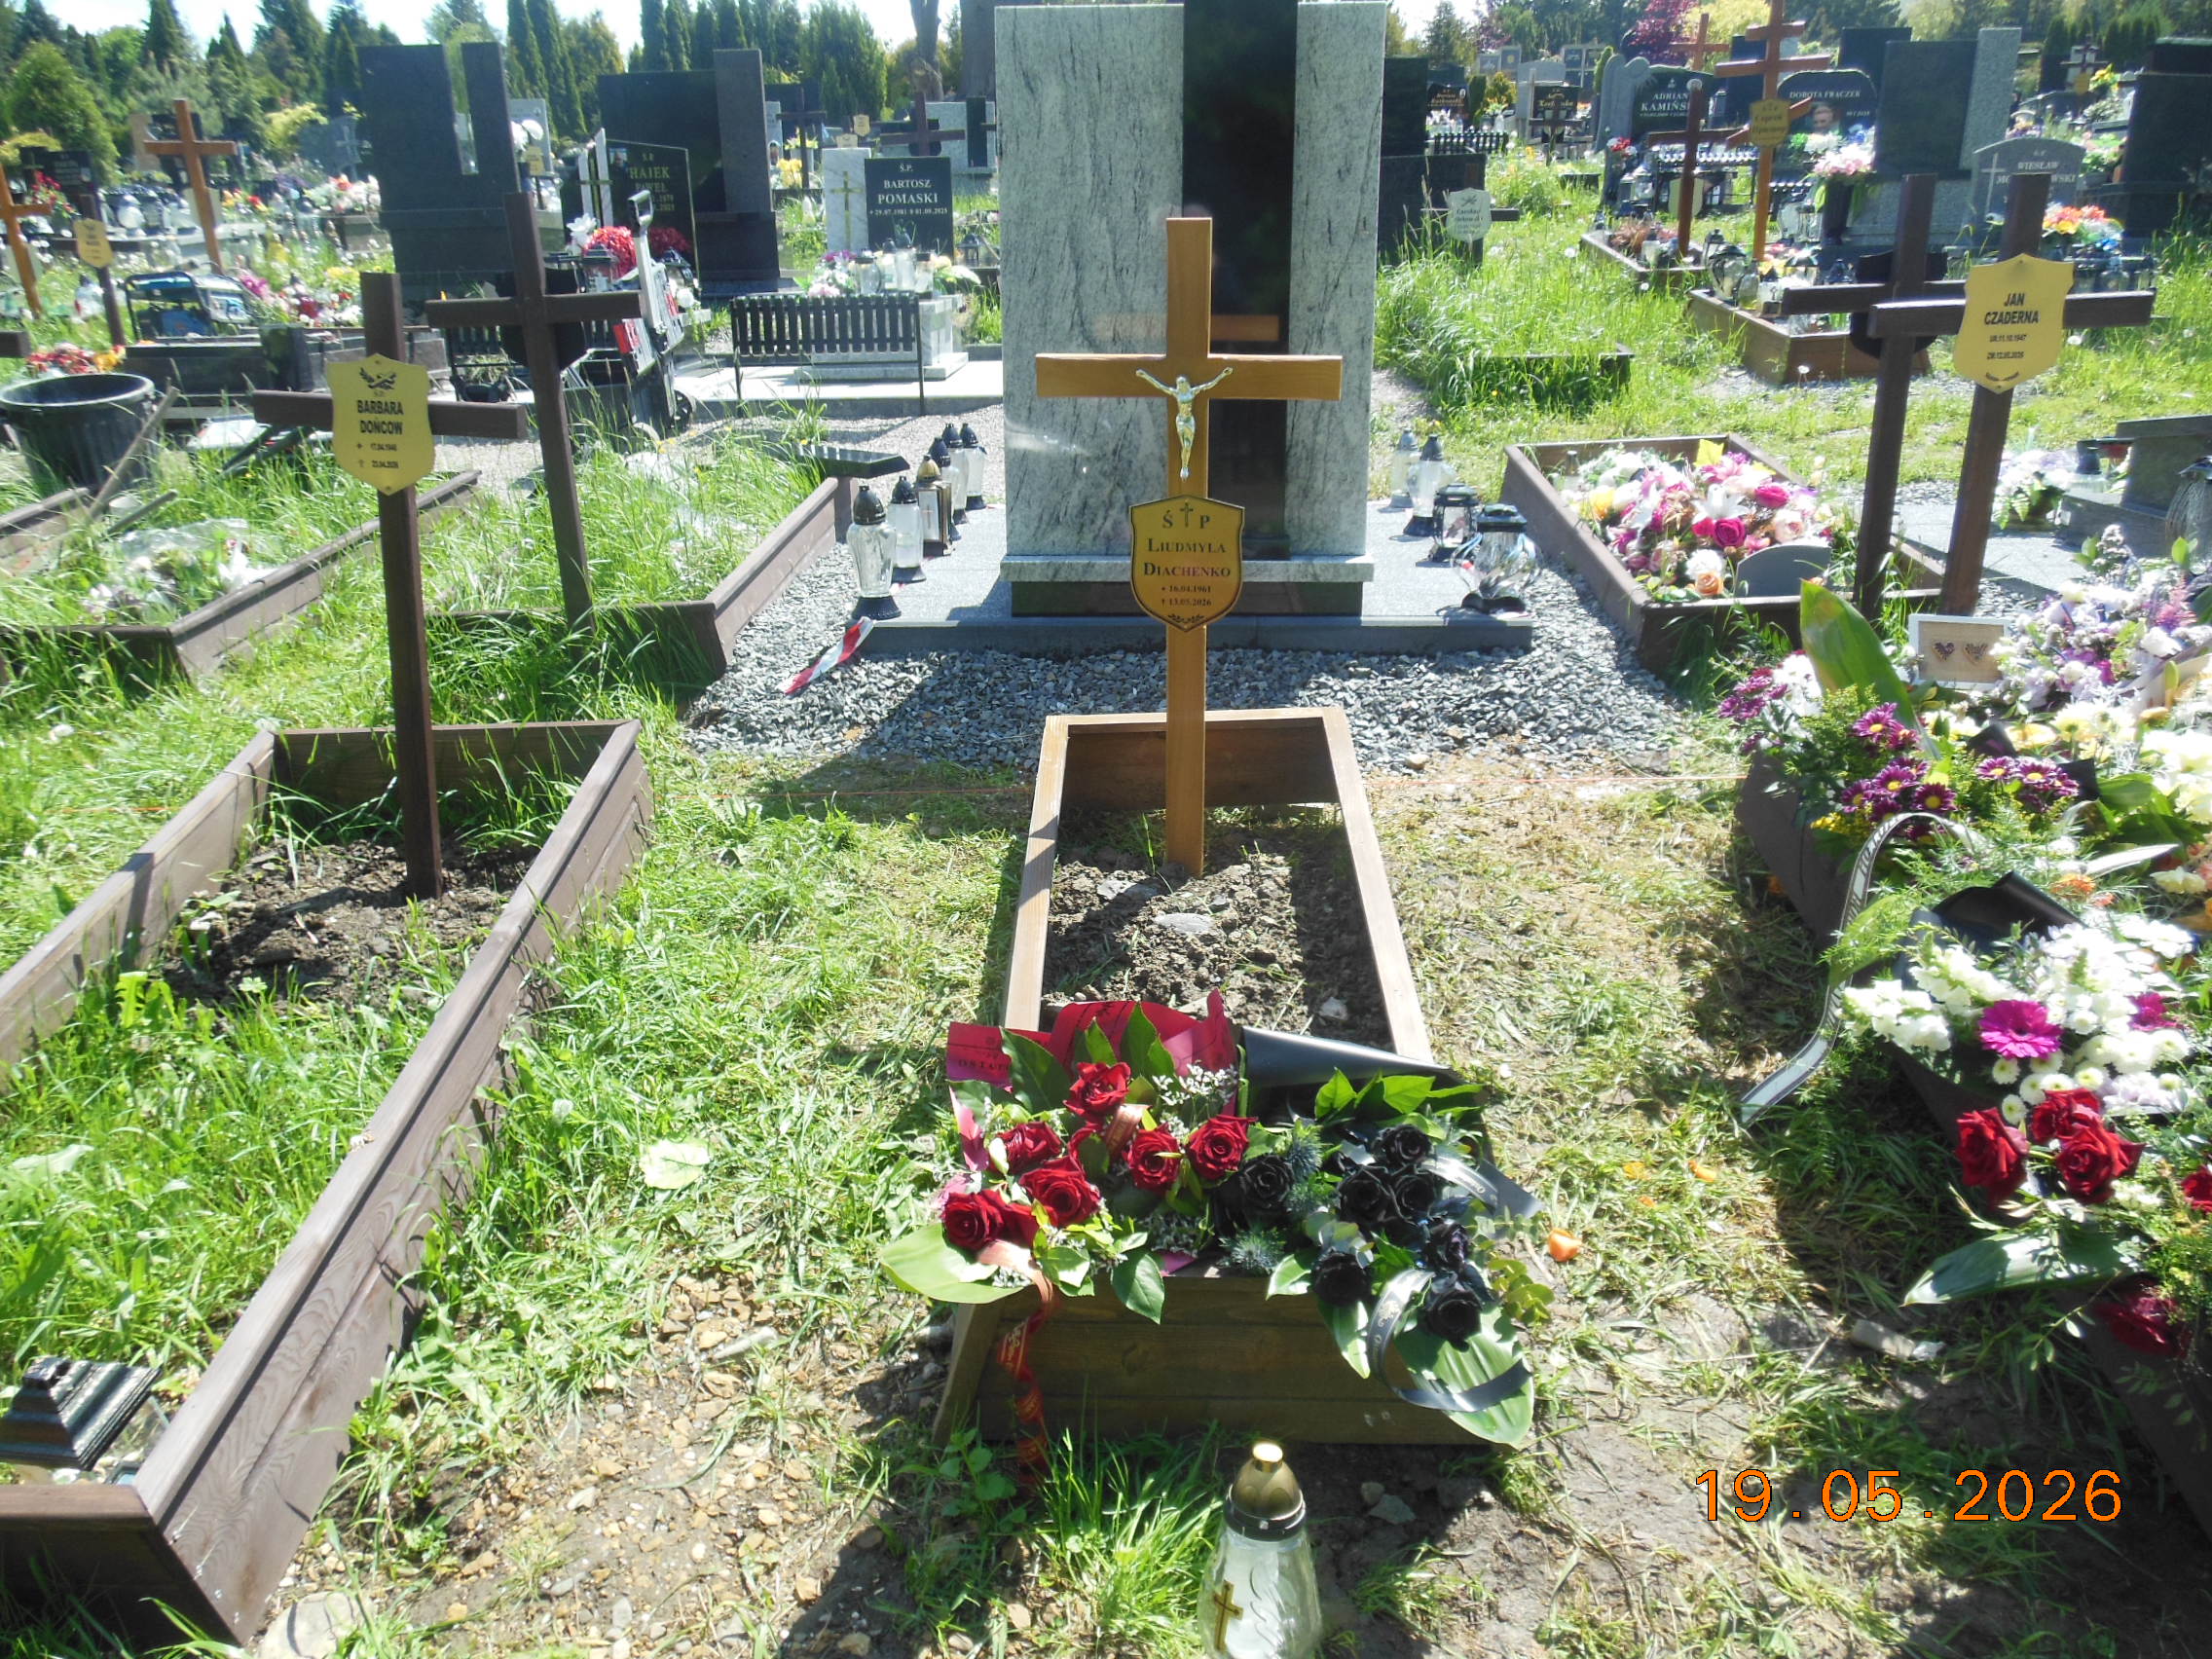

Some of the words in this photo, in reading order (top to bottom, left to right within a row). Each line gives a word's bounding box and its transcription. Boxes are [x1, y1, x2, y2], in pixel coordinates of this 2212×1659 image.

[1641, 100, 1687, 111] KAMIŃS
[900, 163, 913, 172] Ś.P.
[884, 179, 932, 189] BARTOSZ
[878, 193, 939, 204] POMASKI
[2004, 292, 2025, 307] JAN
[1984, 311, 2040, 325] CZADERNA
[356, 399, 404, 415] BARBARA
[359, 417, 404, 435] DOŃCOW
[1162, 509, 1174, 529] Ś
[1199, 514, 1211, 529] P
[1143, 562, 1231, 577] DIACHENKO
